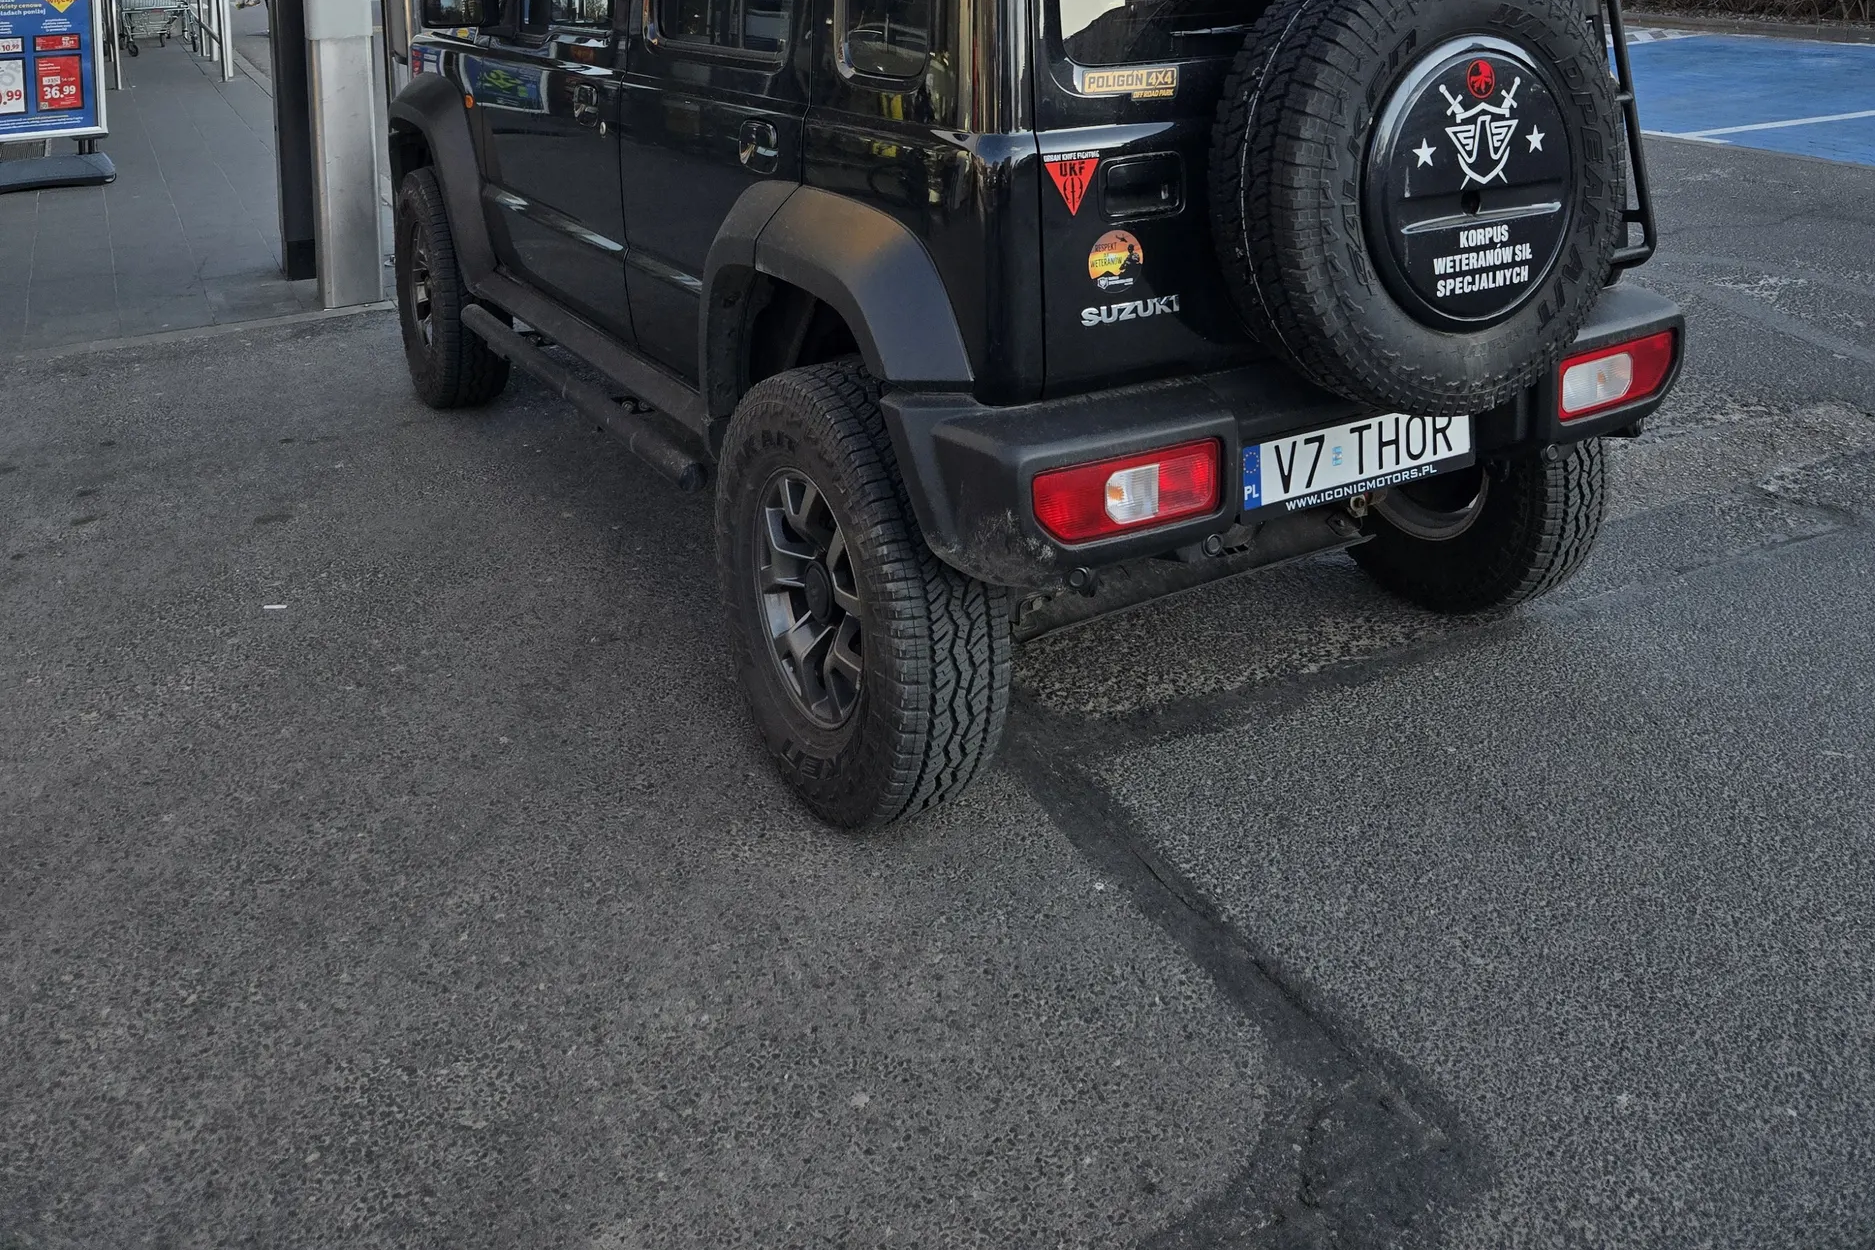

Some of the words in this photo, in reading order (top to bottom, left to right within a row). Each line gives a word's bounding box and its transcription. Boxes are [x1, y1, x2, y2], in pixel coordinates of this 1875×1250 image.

[1087, 72, 1143, 89] POLIGON
[43, 85, 76, 100] 36.99
[1043, 153, 1061, 162] URBAN
[1059, 161, 1086, 177] UKF
[1095, 241, 1118, 252] RESPEKT
[1459, 224, 1509, 249] KORPUS
[1433, 243, 1514, 276] WETERANÓW
[1514, 242, 1533, 263] SIŁ
[1436, 265, 1529, 298] SPECJALNYCH
[1080, 294, 1180, 327] SUZUKI
[1274, 434, 1325, 494] V7
[1350, 414, 1453, 475] THOR
[1244, 485, 1259, 501] PL
[1285, 464, 1438, 511] WWW.ICONICMOTORS.PL
